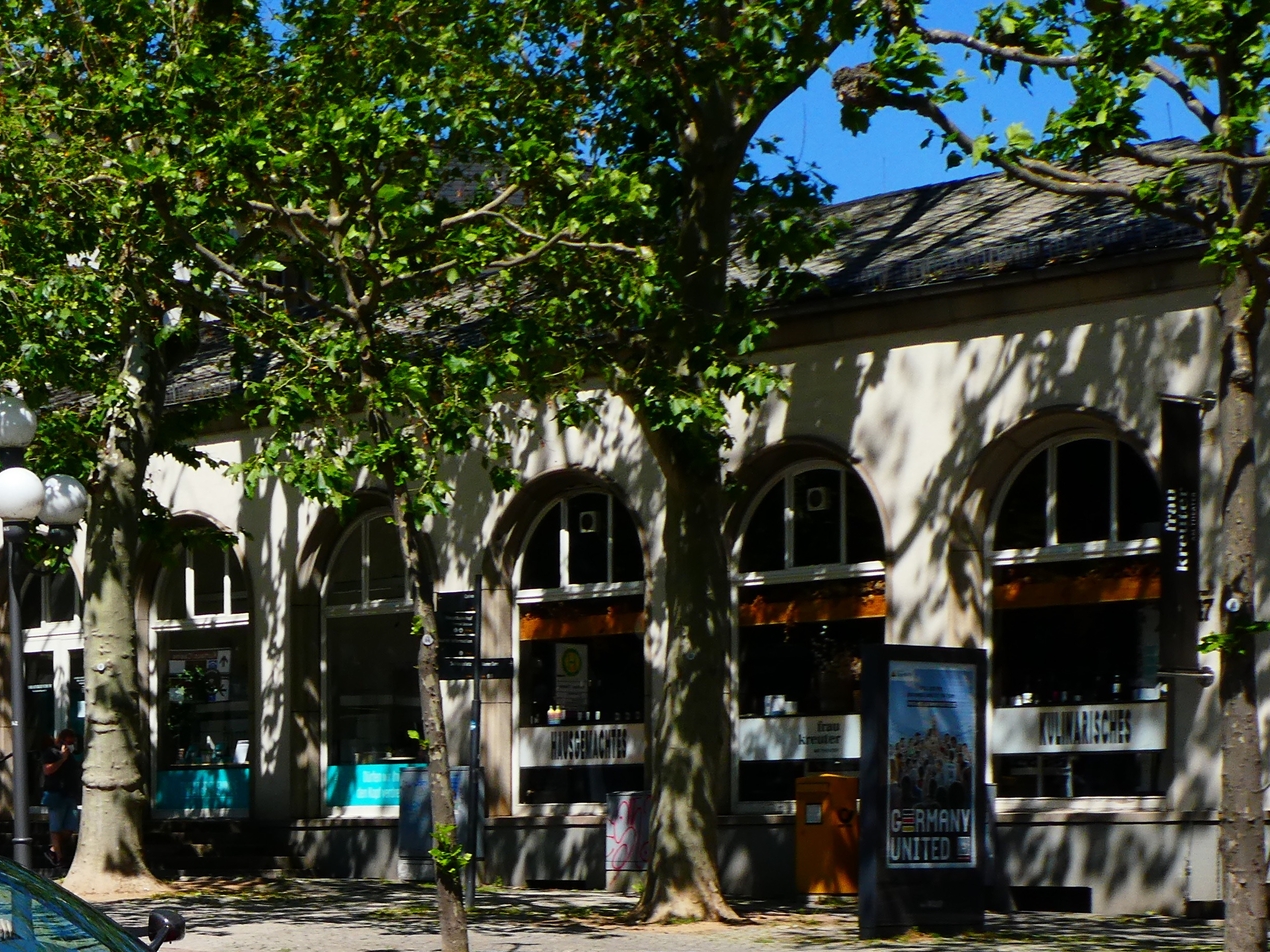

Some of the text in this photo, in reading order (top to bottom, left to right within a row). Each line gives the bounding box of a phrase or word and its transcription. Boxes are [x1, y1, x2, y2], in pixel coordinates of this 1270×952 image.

[1164, 488, 1177, 532] frau
[1176, 487, 1189, 572] kreuter
[798, 734, 842, 745] kreuter
[816, 720, 841, 732] frau
[1039, 709, 1132, 745] KULINARISCHES
[550, 728, 628, 760] HAUSGEMACHTES
[890, 808, 971, 833] GERMANY
[889, 836, 951, 861] UNITED
